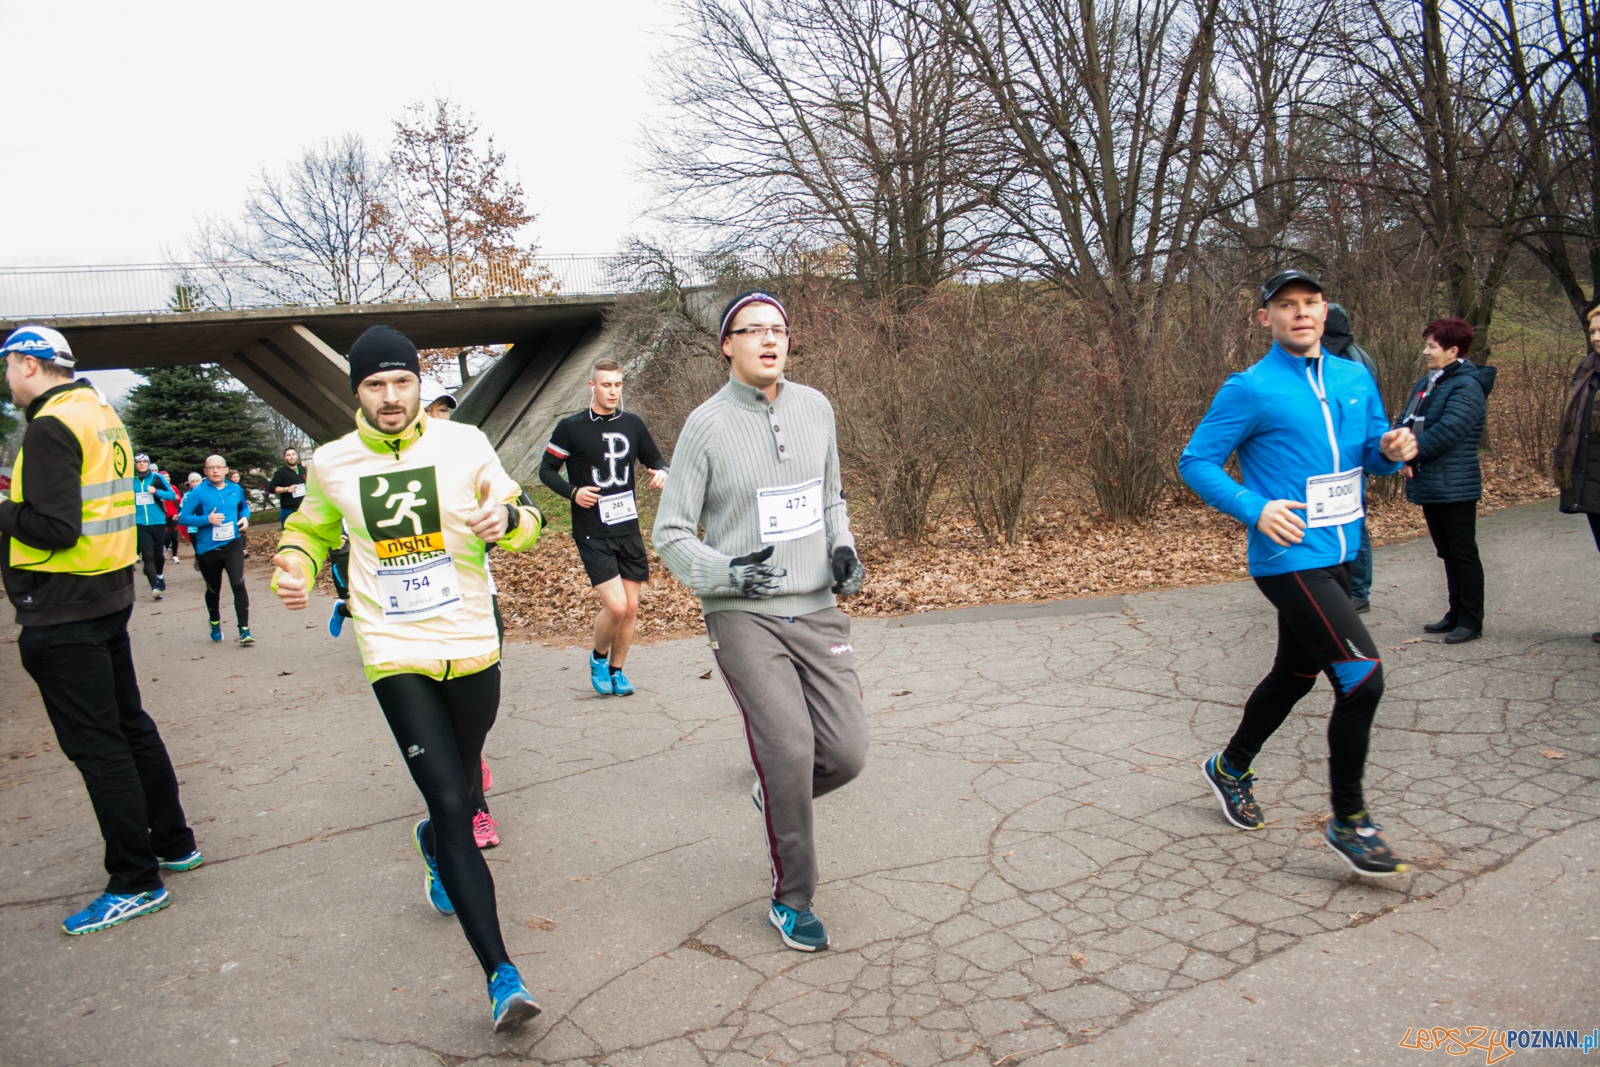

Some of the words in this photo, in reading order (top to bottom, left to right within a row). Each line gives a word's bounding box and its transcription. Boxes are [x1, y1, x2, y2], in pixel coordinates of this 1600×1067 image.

[1328, 483, 1352, 497] 1000
[612, 501, 624, 510] 245
[785, 496, 807, 510] 472
[387, 535, 432, 553] night
[402, 575, 430, 591] 754
